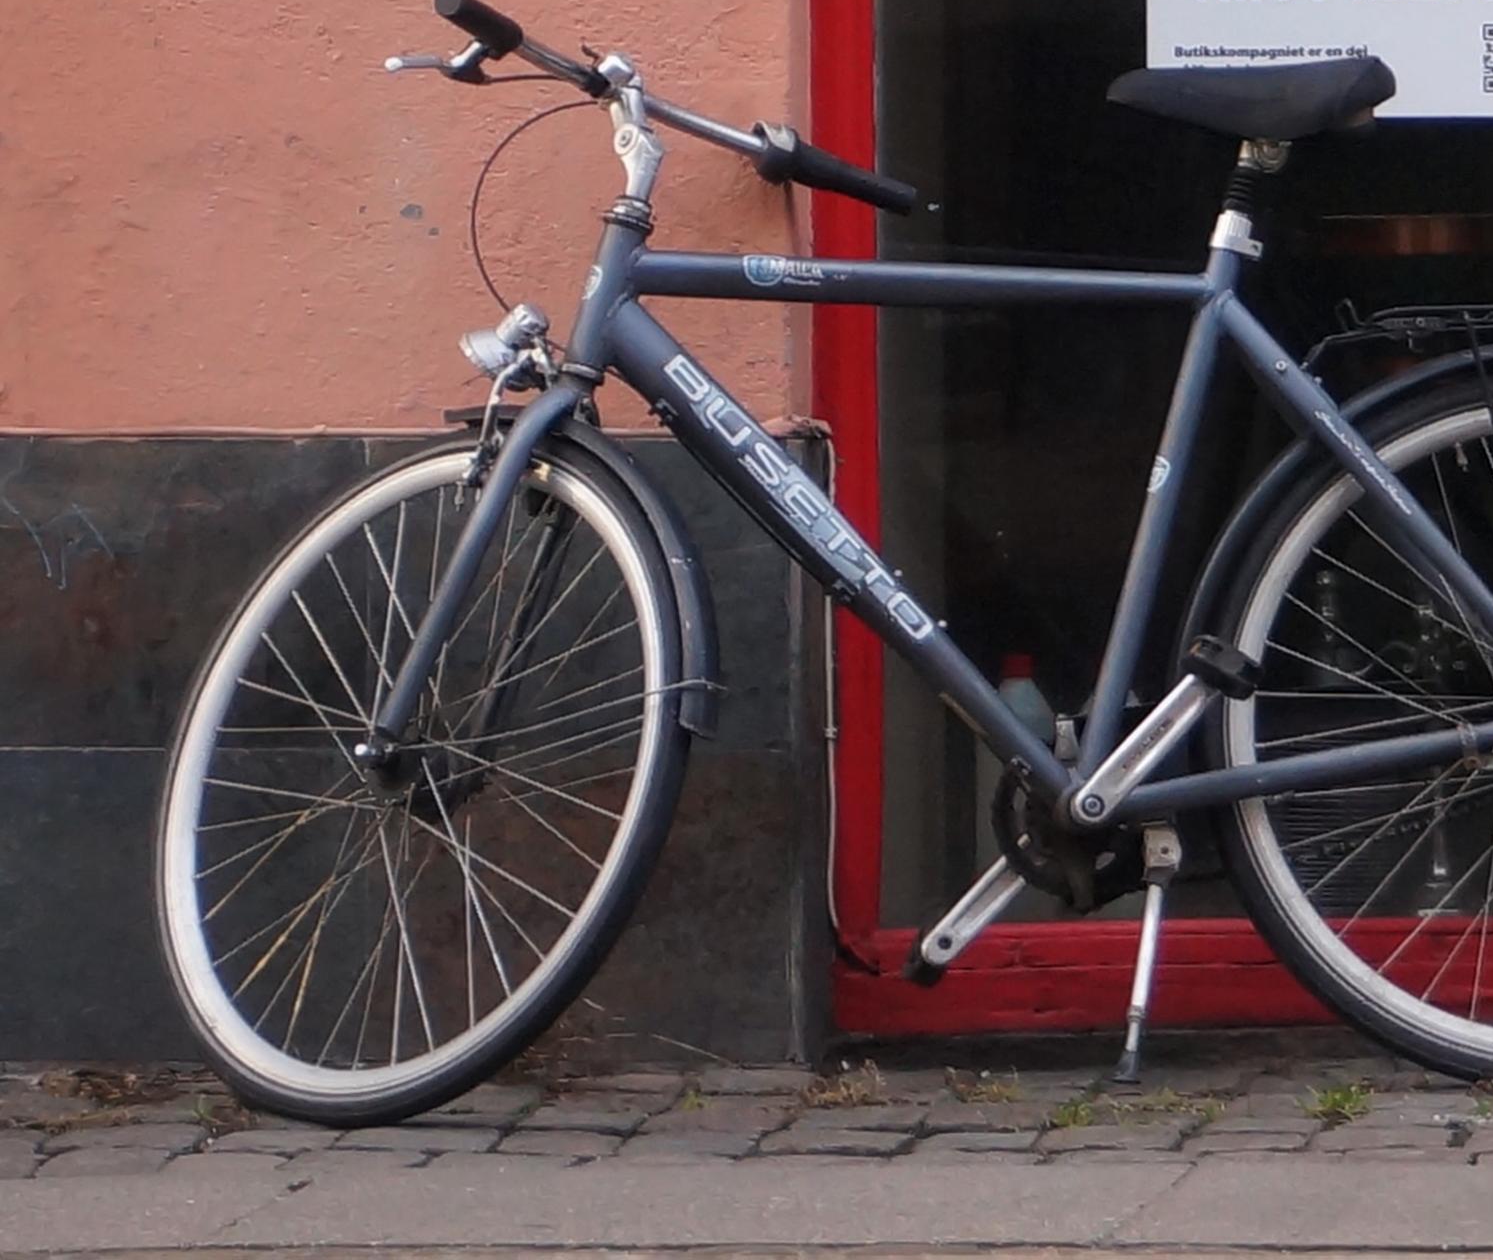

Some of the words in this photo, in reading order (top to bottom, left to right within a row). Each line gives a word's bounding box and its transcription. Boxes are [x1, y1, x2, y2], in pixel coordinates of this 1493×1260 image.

[1174, 46, 1305, 61] Butikskompagniet
[1307, 49, 1322, 57] er
[1326, 48, 1342, 57] en
[664, 354, 934, 640] BUSETTO
